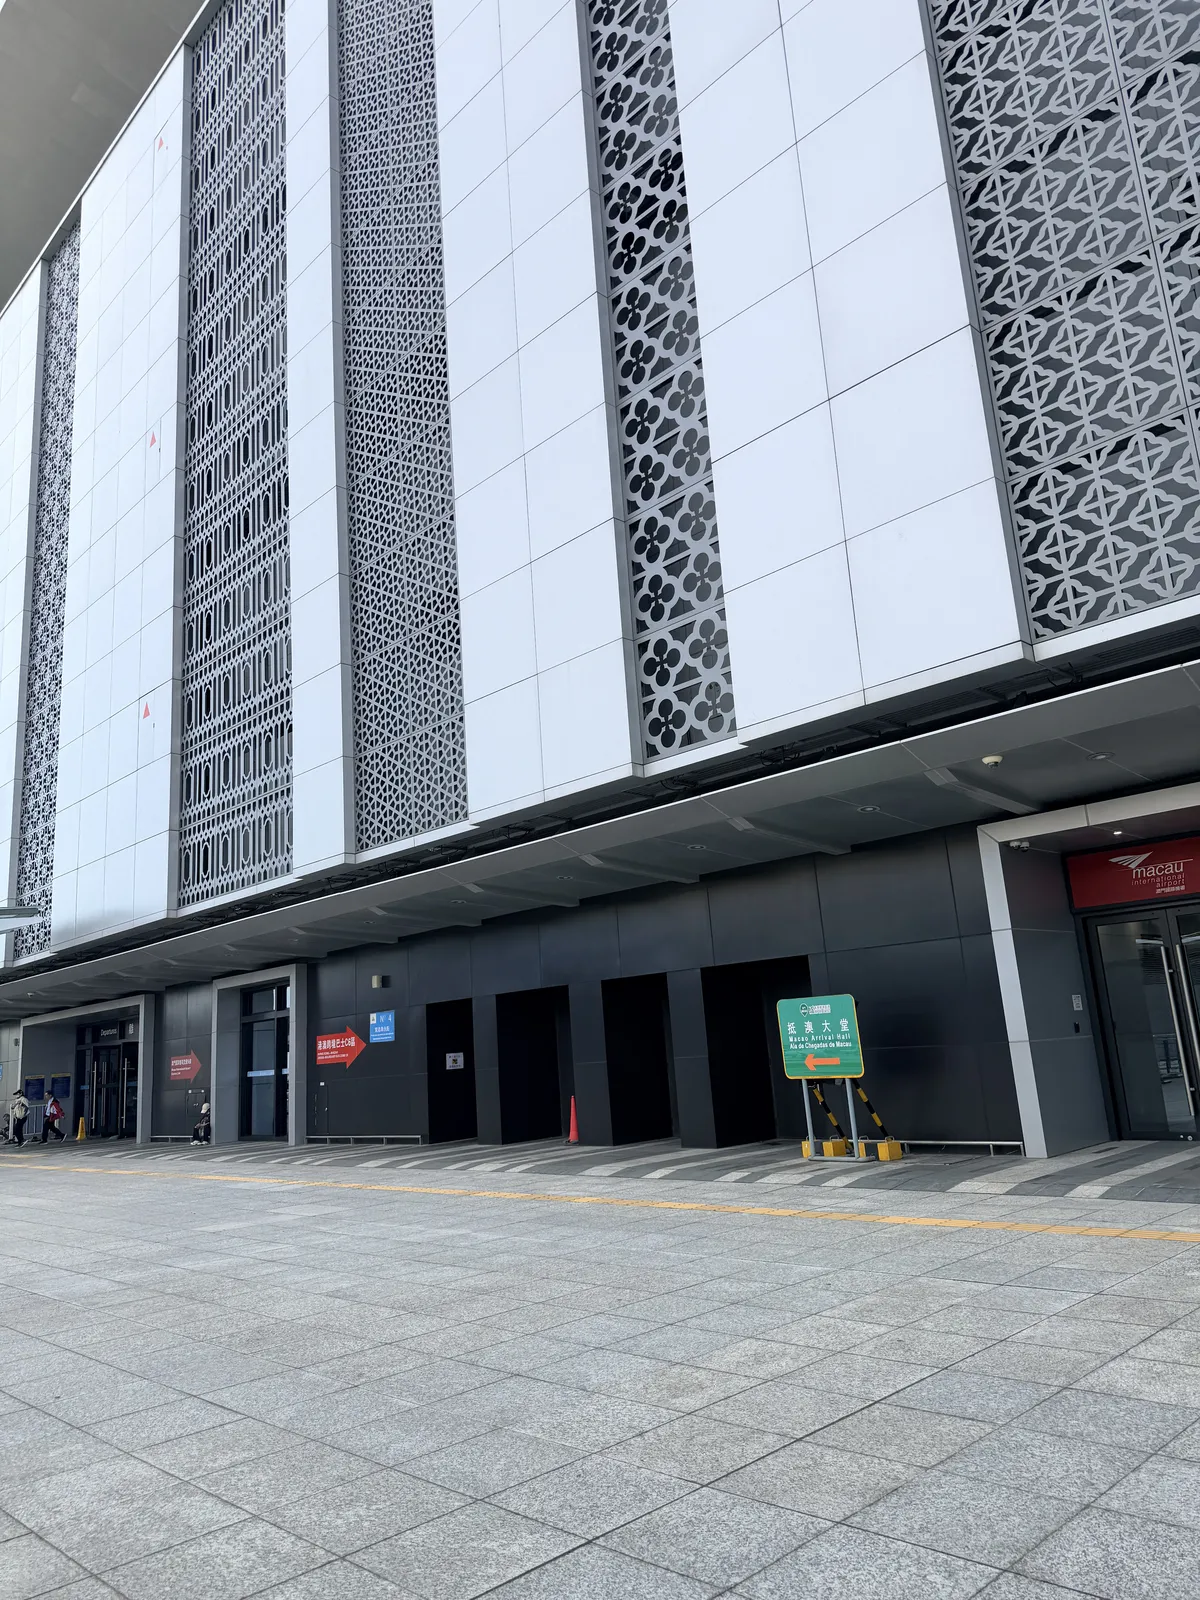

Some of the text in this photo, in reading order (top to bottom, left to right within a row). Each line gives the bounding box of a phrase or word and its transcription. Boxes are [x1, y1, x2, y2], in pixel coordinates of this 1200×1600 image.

[1132, 862, 1184, 878] macau
[1131, 872, 1185, 886] international
[1156, 879, 1185, 888] airport
[787, 1018, 849, 1034] 抵澳大堂
[804, 1041, 828, 1050] Chegadas
[835, 1040, 852, 1048] Macau
